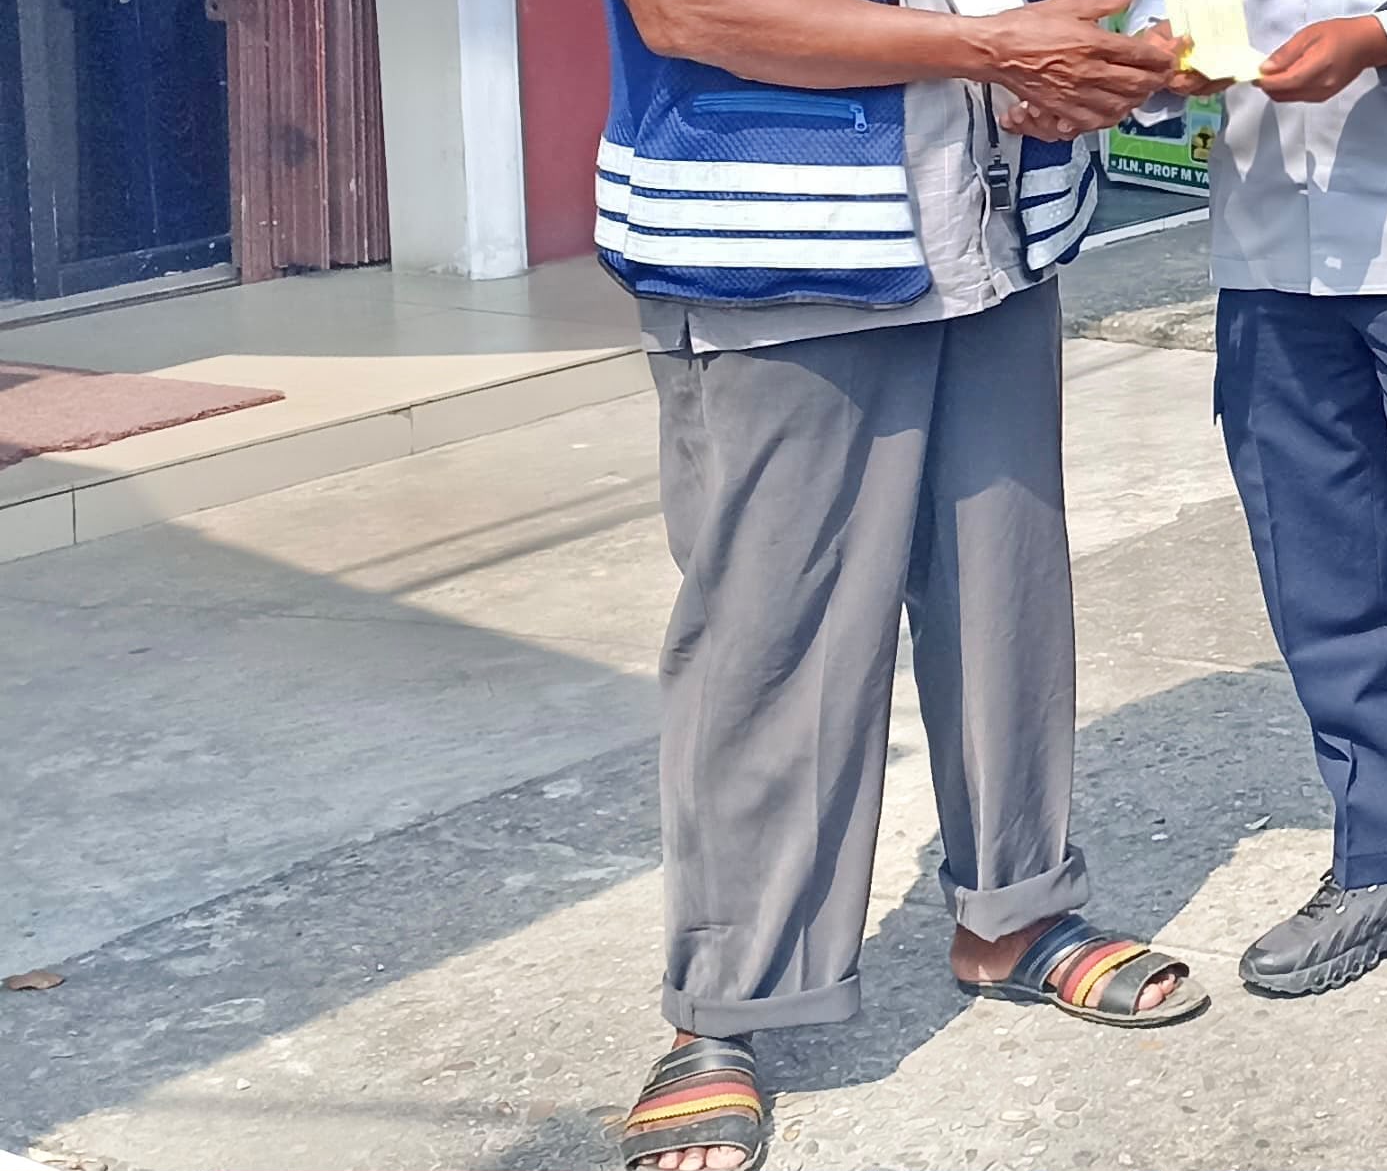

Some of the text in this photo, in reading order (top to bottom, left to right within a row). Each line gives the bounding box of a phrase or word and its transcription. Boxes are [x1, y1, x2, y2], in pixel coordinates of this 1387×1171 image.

[1116, 157, 1142, 173] JLN.
[1144, 162, 1179, 179] PROF
[1180, 168, 1192, 182] M
